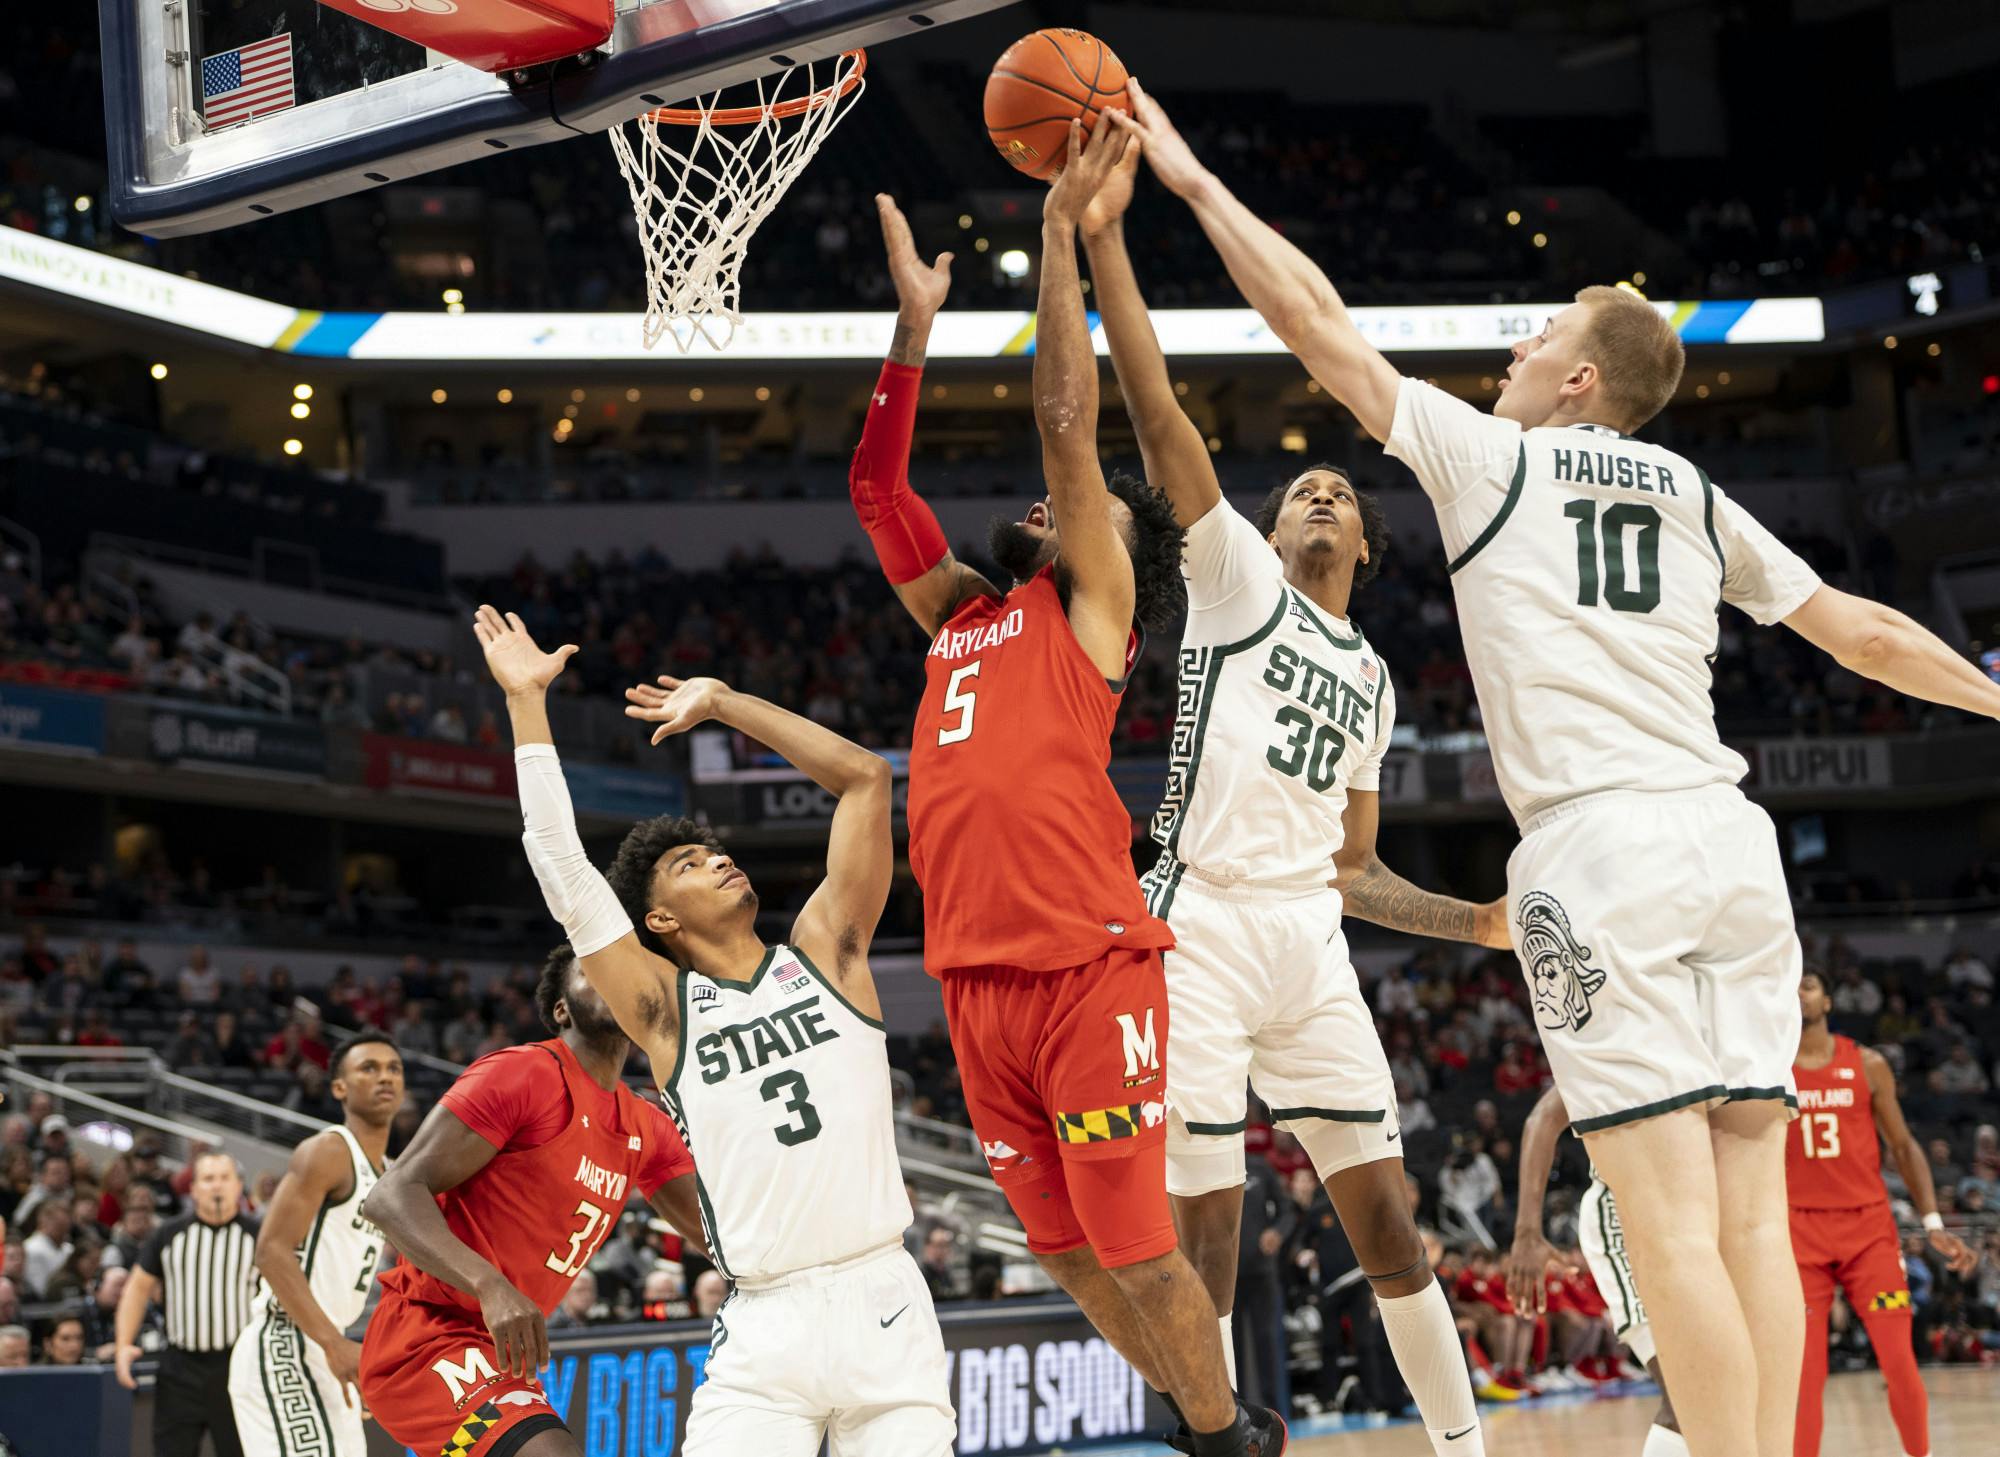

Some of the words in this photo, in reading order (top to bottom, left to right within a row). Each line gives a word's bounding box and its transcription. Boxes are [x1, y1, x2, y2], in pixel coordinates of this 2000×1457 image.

[1551, 448, 1679, 497] HAUSER
[1563, 498, 1663, 614] 10
[937, 658, 982, 748] 5
[1262, 643, 1374, 745] STATE
[1265, 703, 1346, 794] 30
[1767, 747, 1869, 785] IUPUI
[695, 995, 841, 1086] STATE
[1114, 1006, 1161, 1078] M
[759, 1068, 823, 1147] 3
[1797, 1087, 1854, 1109] RYLAND
[1800, 1112, 1841, 1159] 13
[354, 1245, 377, 1292] 2
[431, 1347, 500, 1405] M
[585, 1346, 678, 1457] B1G
[958, 1343, 1030, 1454] B1G
